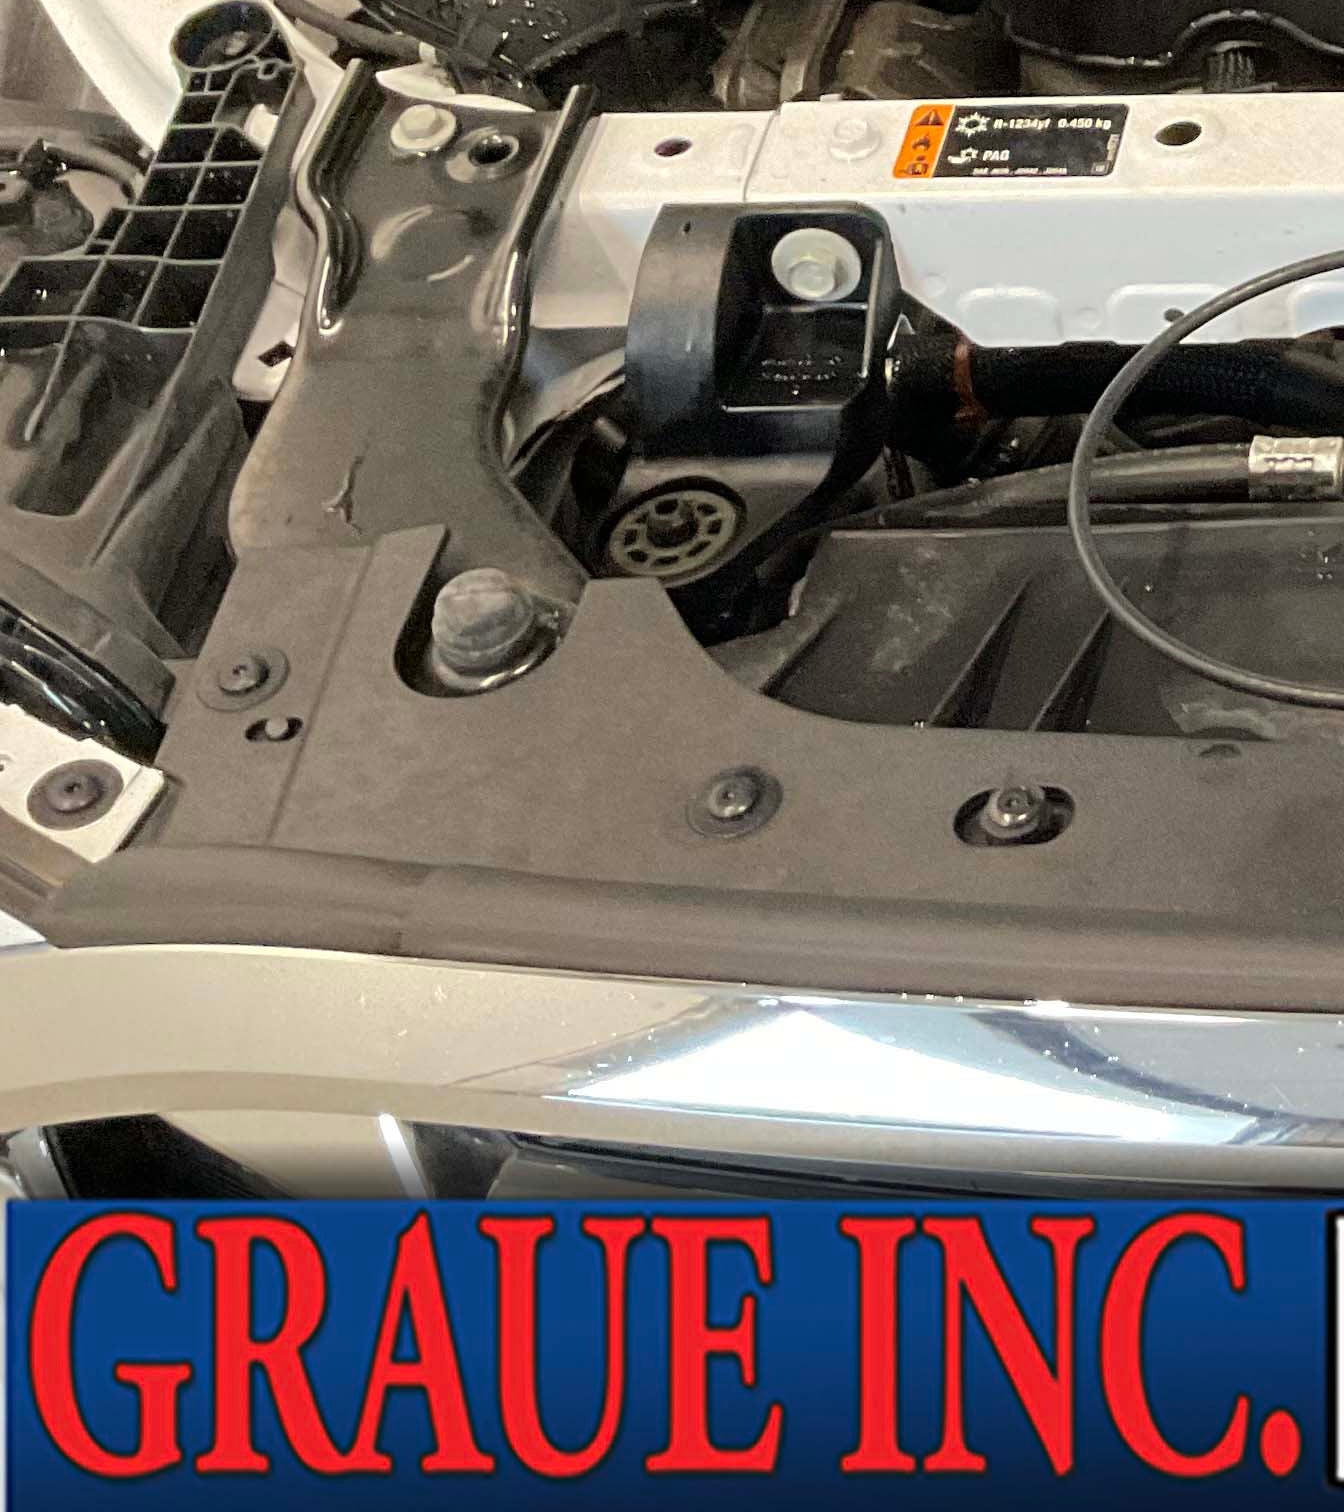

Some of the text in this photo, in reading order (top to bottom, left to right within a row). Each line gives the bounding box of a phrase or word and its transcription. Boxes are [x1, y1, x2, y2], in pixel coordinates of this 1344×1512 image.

[993, 117, 1051, 130] R-1234yf
[1095, 117, 1112, 130] kg
[982, 150, 1010, 161] PAG
